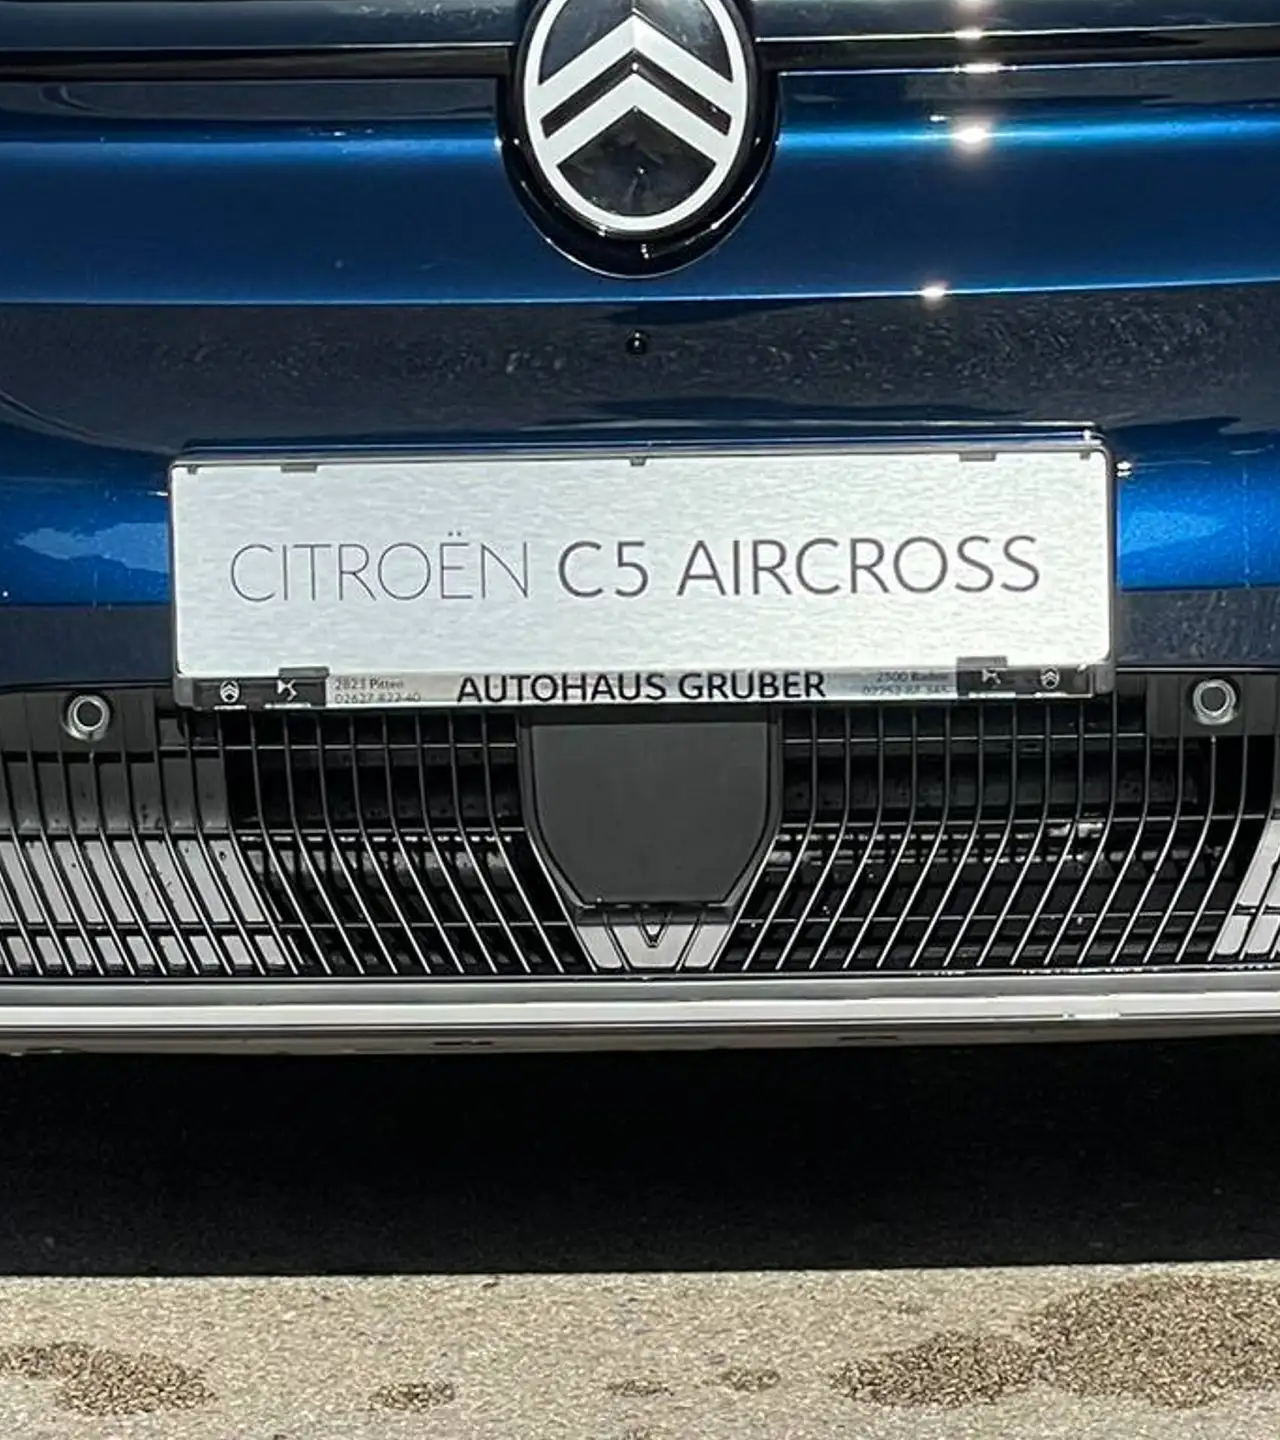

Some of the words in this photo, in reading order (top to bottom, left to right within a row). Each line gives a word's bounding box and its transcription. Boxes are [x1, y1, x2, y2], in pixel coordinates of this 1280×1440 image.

[230, 531, 529, 602] CITROËN
[557, 540, 650, 599] C5
[676, 535, 1041, 596] AIRCROSS
[456, 673, 667, 703] AUTOHAUS
[678, 670, 827, 700] GRUBER
